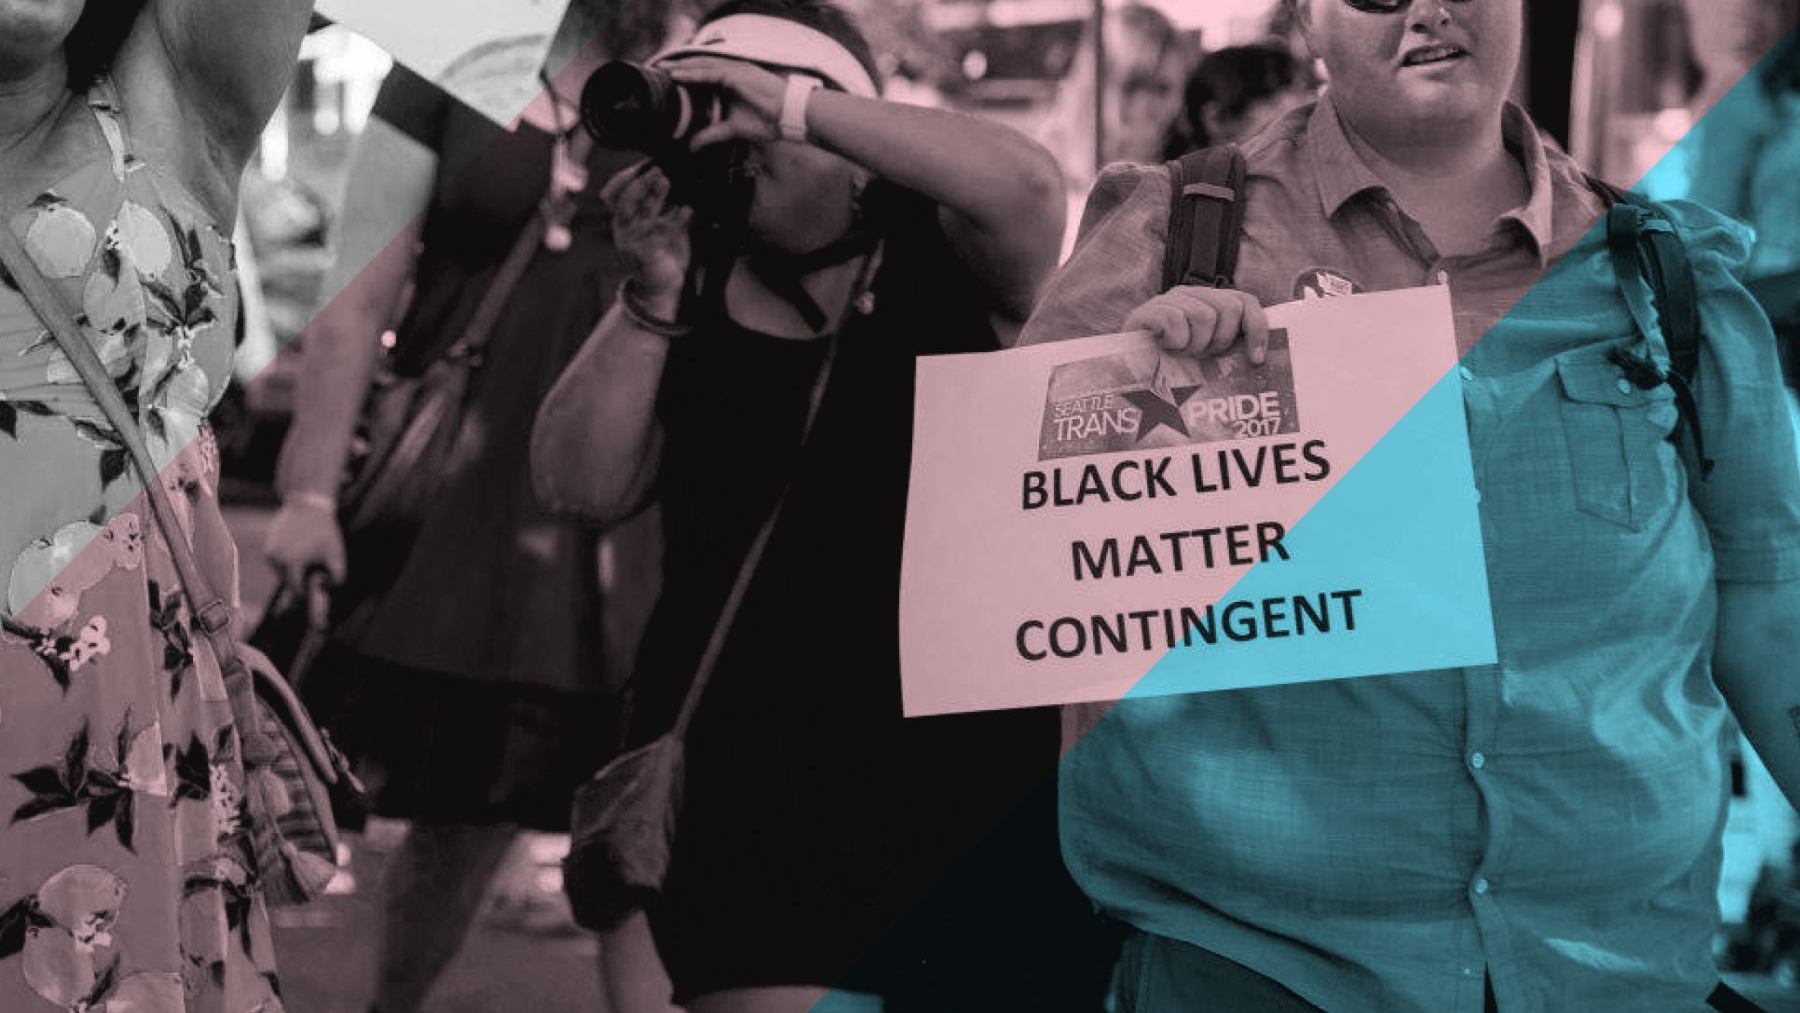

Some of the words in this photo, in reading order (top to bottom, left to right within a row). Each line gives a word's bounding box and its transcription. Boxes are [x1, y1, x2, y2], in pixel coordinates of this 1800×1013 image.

[1053, 407, 1140, 442] TRANS
[1186, 390, 1281, 423] PRIDE
[1054, 395, 1115, 419] SEATTLE
[1234, 416, 1281, 439] 2017
[1021, 456, 1177, 510] BLACK
[1192, 439, 1331, 494] LIVES
[1070, 520, 1290, 581] MATTER
[1015, 589, 1363, 662] CONTINGENT
